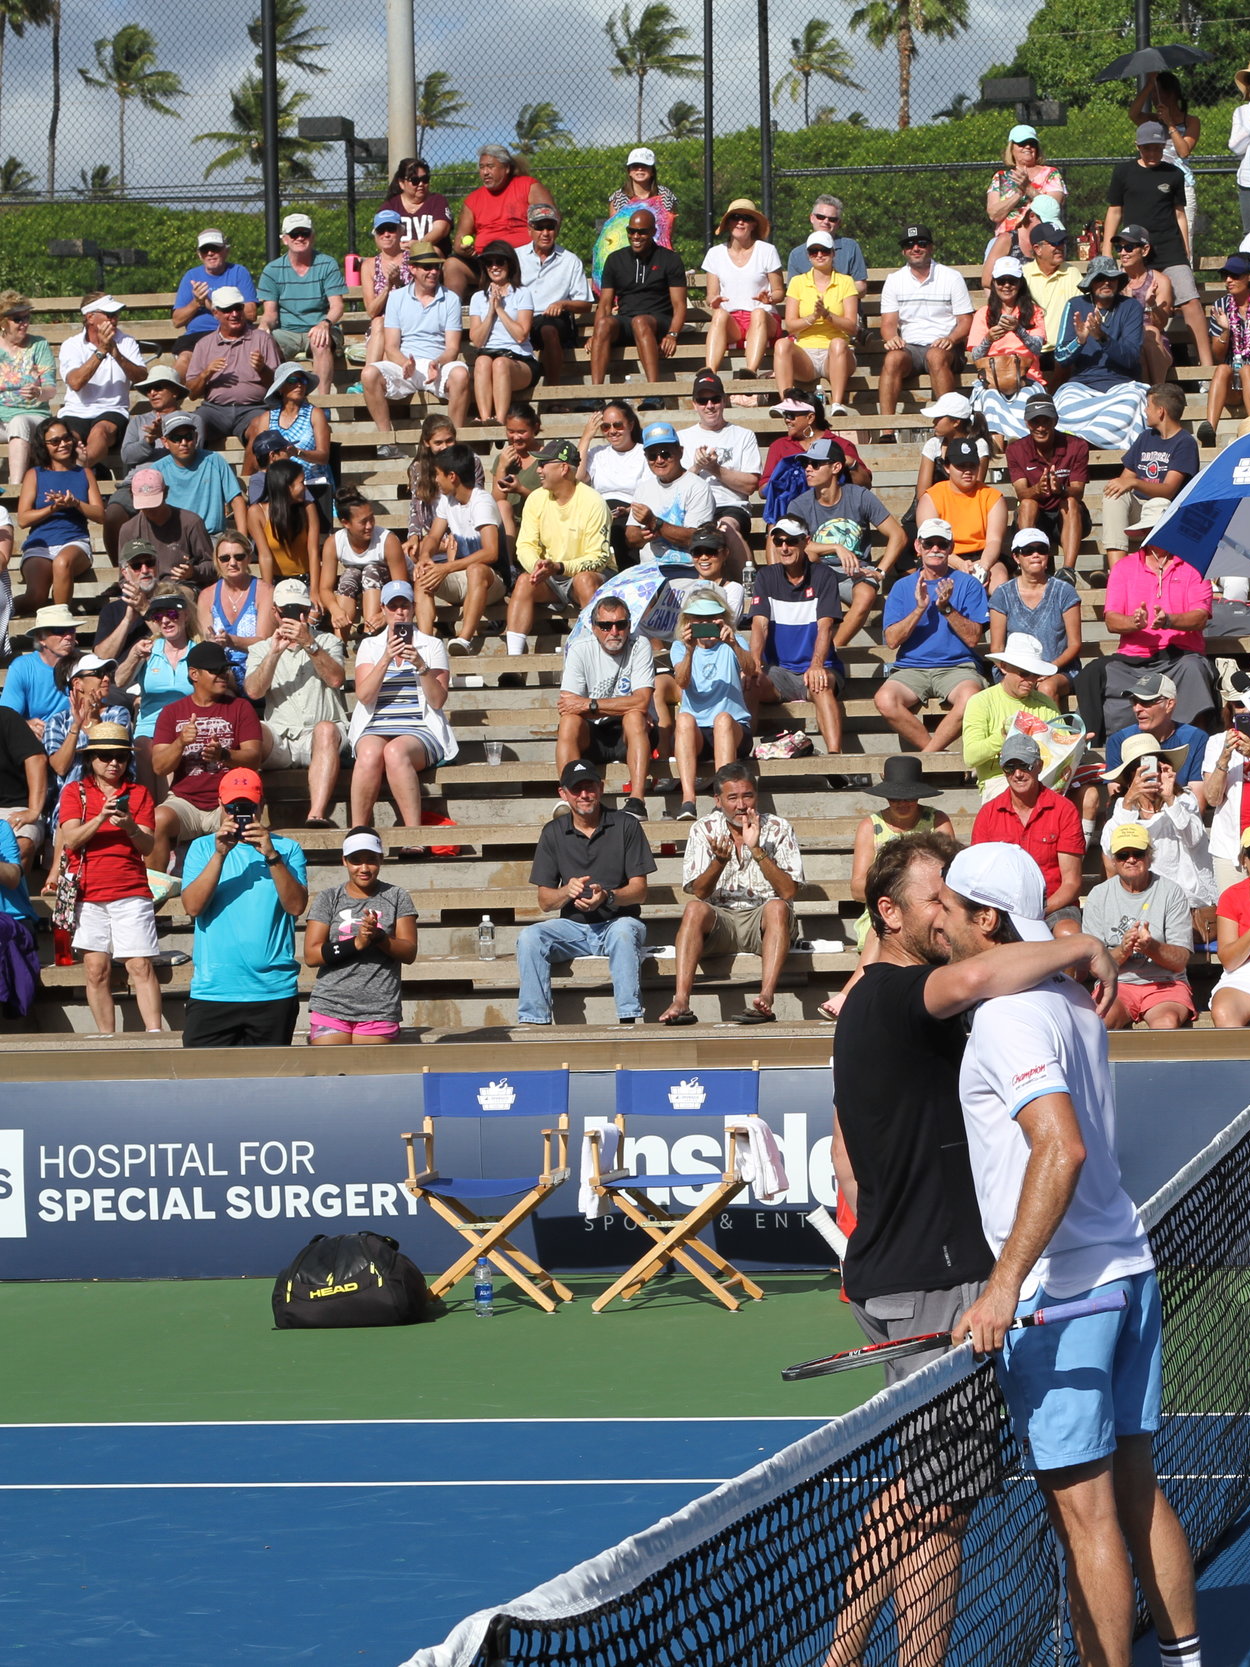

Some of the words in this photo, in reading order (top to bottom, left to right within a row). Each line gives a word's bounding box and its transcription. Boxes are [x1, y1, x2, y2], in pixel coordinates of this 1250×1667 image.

[39, 1142, 228, 1179] HOSPITAL
[239, 1140, 316, 1176] FOR
[38, 1186, 217, 1223] SPECIAL
[226, 1182, 420, 1219] SURGERY
[308, 1281, 359, 1299] HEAD
